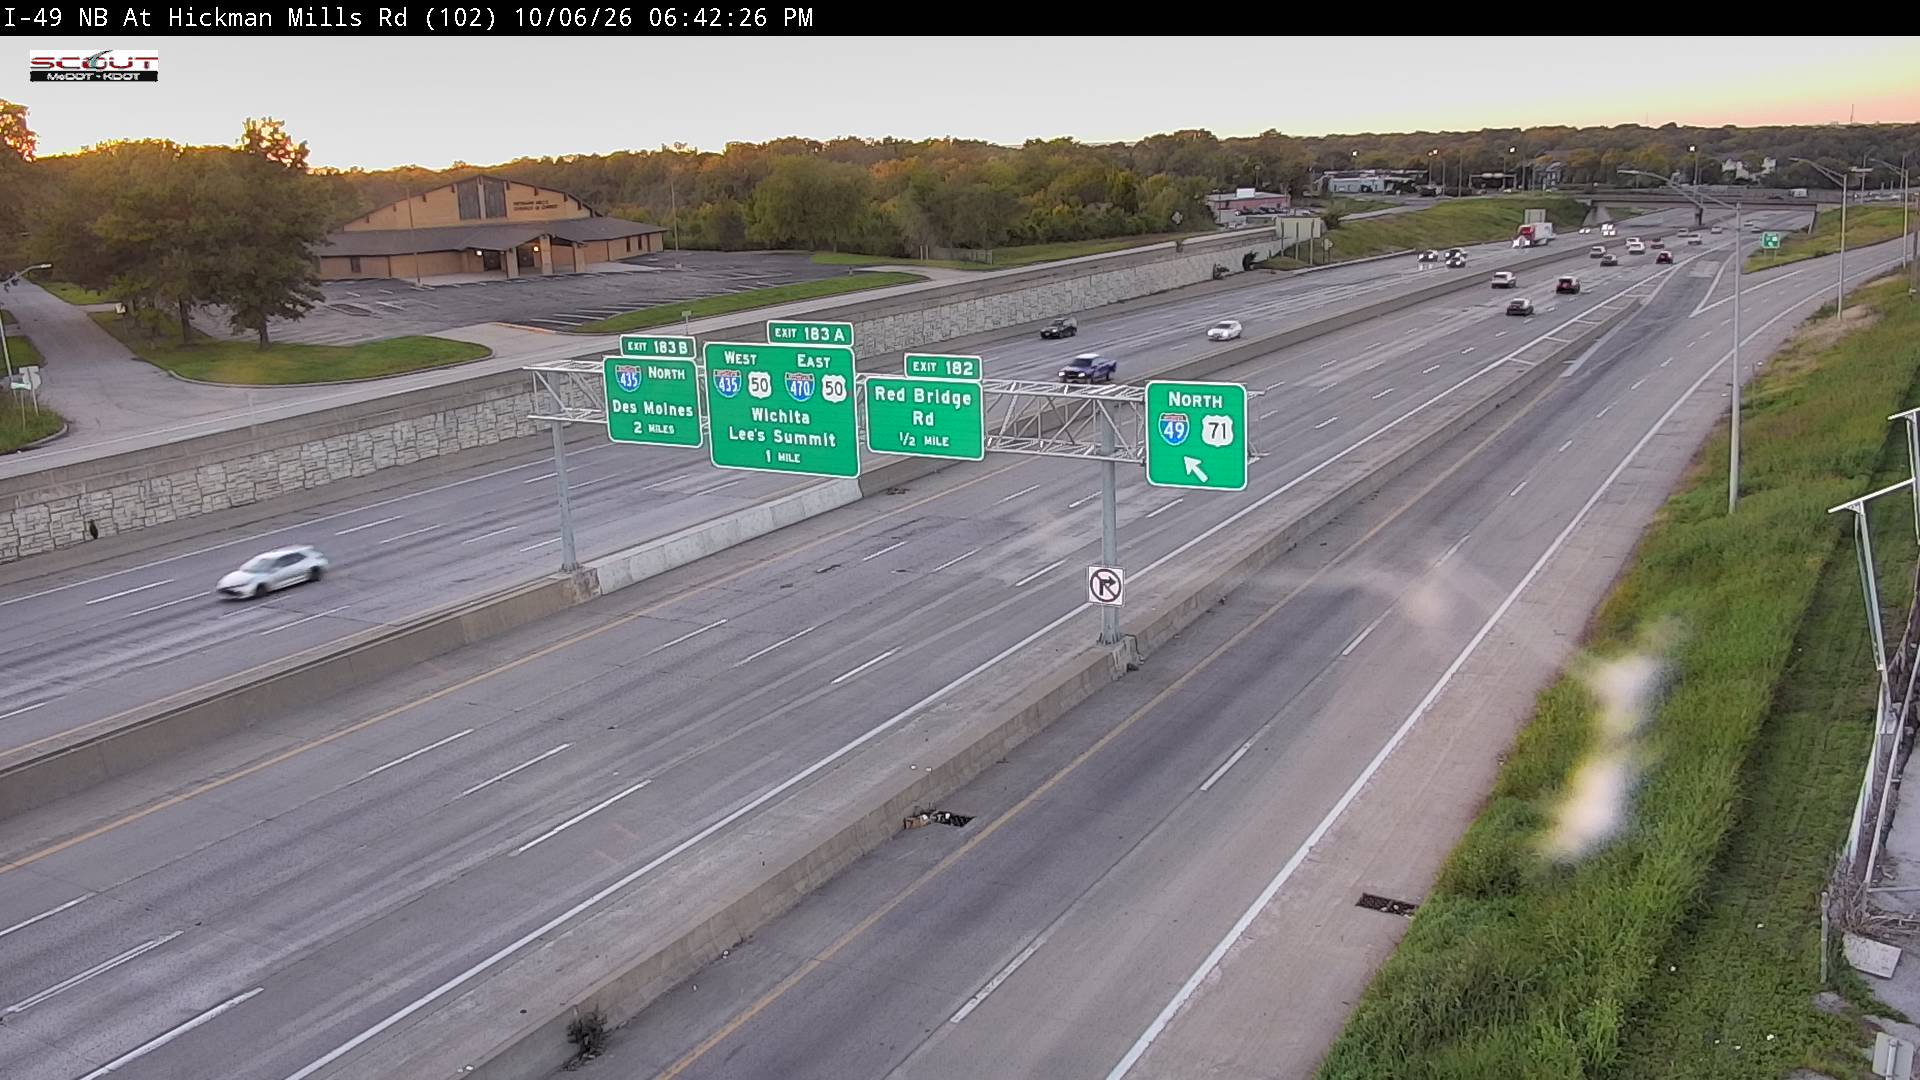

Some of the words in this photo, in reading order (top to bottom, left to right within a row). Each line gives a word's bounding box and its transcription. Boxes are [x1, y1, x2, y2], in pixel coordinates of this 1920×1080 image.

[774, 327, 797, 339] EXIT
[627, 341, 647, 351] EXIT
[913, 361, 937, 372] EXIT
[946, 361, 973, 376] 182
[620, 372, 638, 388] 435
[718, 377, 738, 393] 435
[751, 377, 769, 393] 50
[790, 381, 811, 397] 470
[825, 380, 844, 397] 50
[874, 386, 905, 402] Red
[914, 388, 972, 410] Bridge
[612, 399, 637, 414] Des
[643, 401, 694, 417] Moines
[751, 407, 811, 425] Wichita
[912, 410, 934, 426] Rd
[633, 421, 643, 434] 2
[648, 423, 675, 435] MILES
[1163, 421, 1185, 440] 49
[1208, 421, 1227, 440] 71
[729, 426, 766, 442] Lee's
[773, 430, 836, 448] Summit
[923, 435, 950, 447] MILE
[765, 450, 772, 463] 1
[778, 452, 801, 463] MILE
